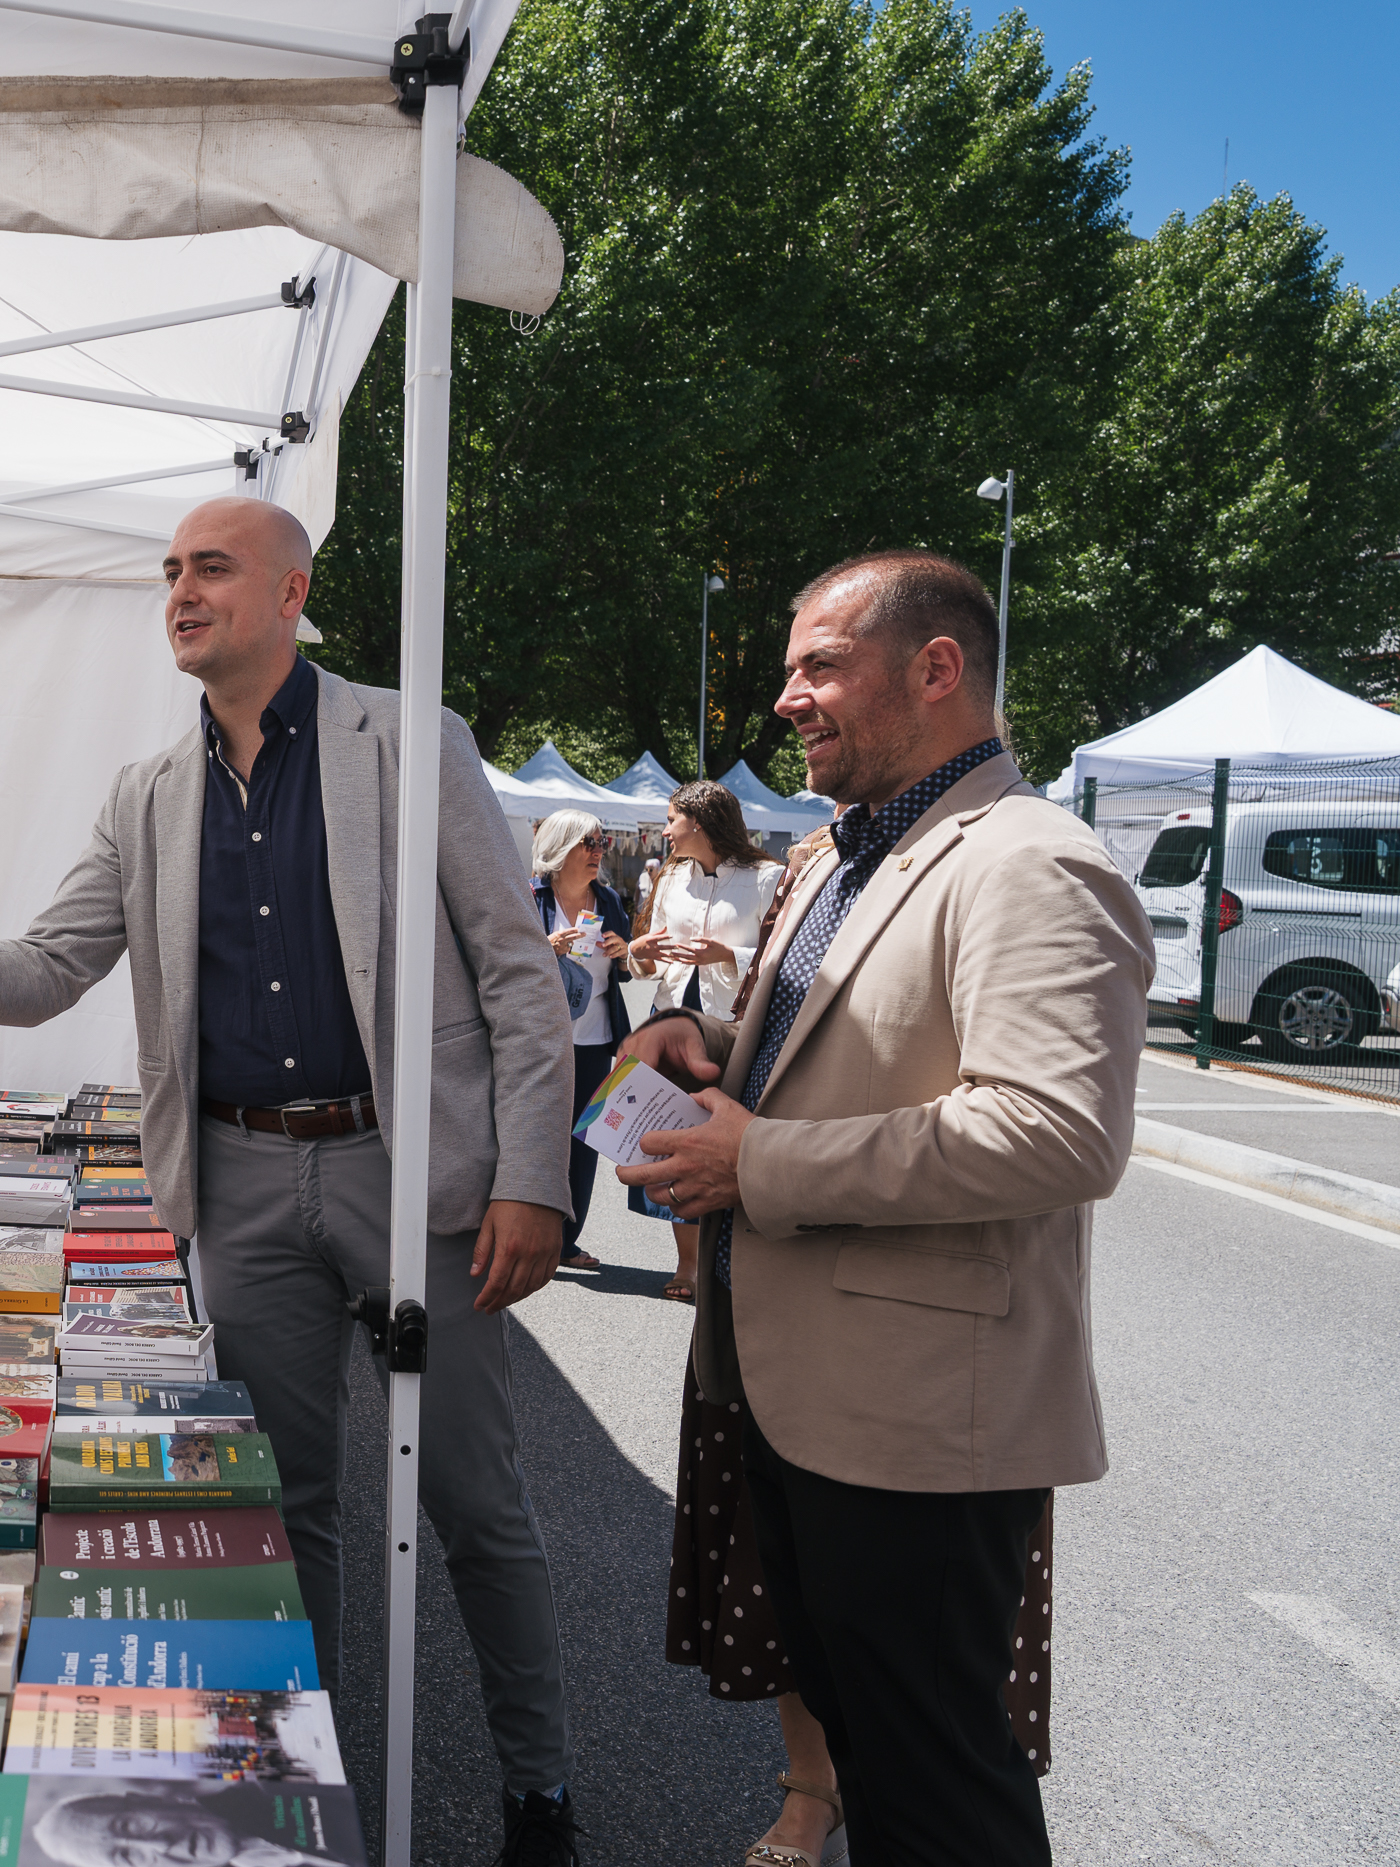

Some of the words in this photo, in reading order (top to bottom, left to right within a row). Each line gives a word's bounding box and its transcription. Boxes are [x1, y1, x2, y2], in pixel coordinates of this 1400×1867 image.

[102, 1380, 124, 1402] VALIRA
[81, 1440, 98, 1468] QUARANTA
[99, 1436, 114, 1456] ESTANYS
[116, 1441, 132, 1468] PIRINENCS
[134, 1441, 149, 1455] NENS
[100, 1460, 114, 1474] CIMS
[136, 1455, 151, 1468] AMB
[75, 1529, 94, 1560] Projecte
[98, 1528, 115, 1555] creació
[120, 1522, 140, 1550] l'Escola
[148, 1519, 166, 1559] Andorrana
[124, 1550, 141, 1559] de
[96, 1586, 112, 1606] antic
[61, 1652, 80, 1677] camí
[90, 1653, 109, 1665] la
[118, 1634, 139, 1689] Constitució
[147, 1641, 168, 1690] d'Andorra
[58, 1677, 77, 1687] El
[93, 1671, 112, 1688] cap
[76, 1694, 99, 1705] 13
[109, 1704, 132, 1748] PANDÈMIA
[139, 1709, 158, 1750] ANDORRA
[71, 1708, 98, 1768] DIVENDRES
[112, 1751, 132, 1761] LA
